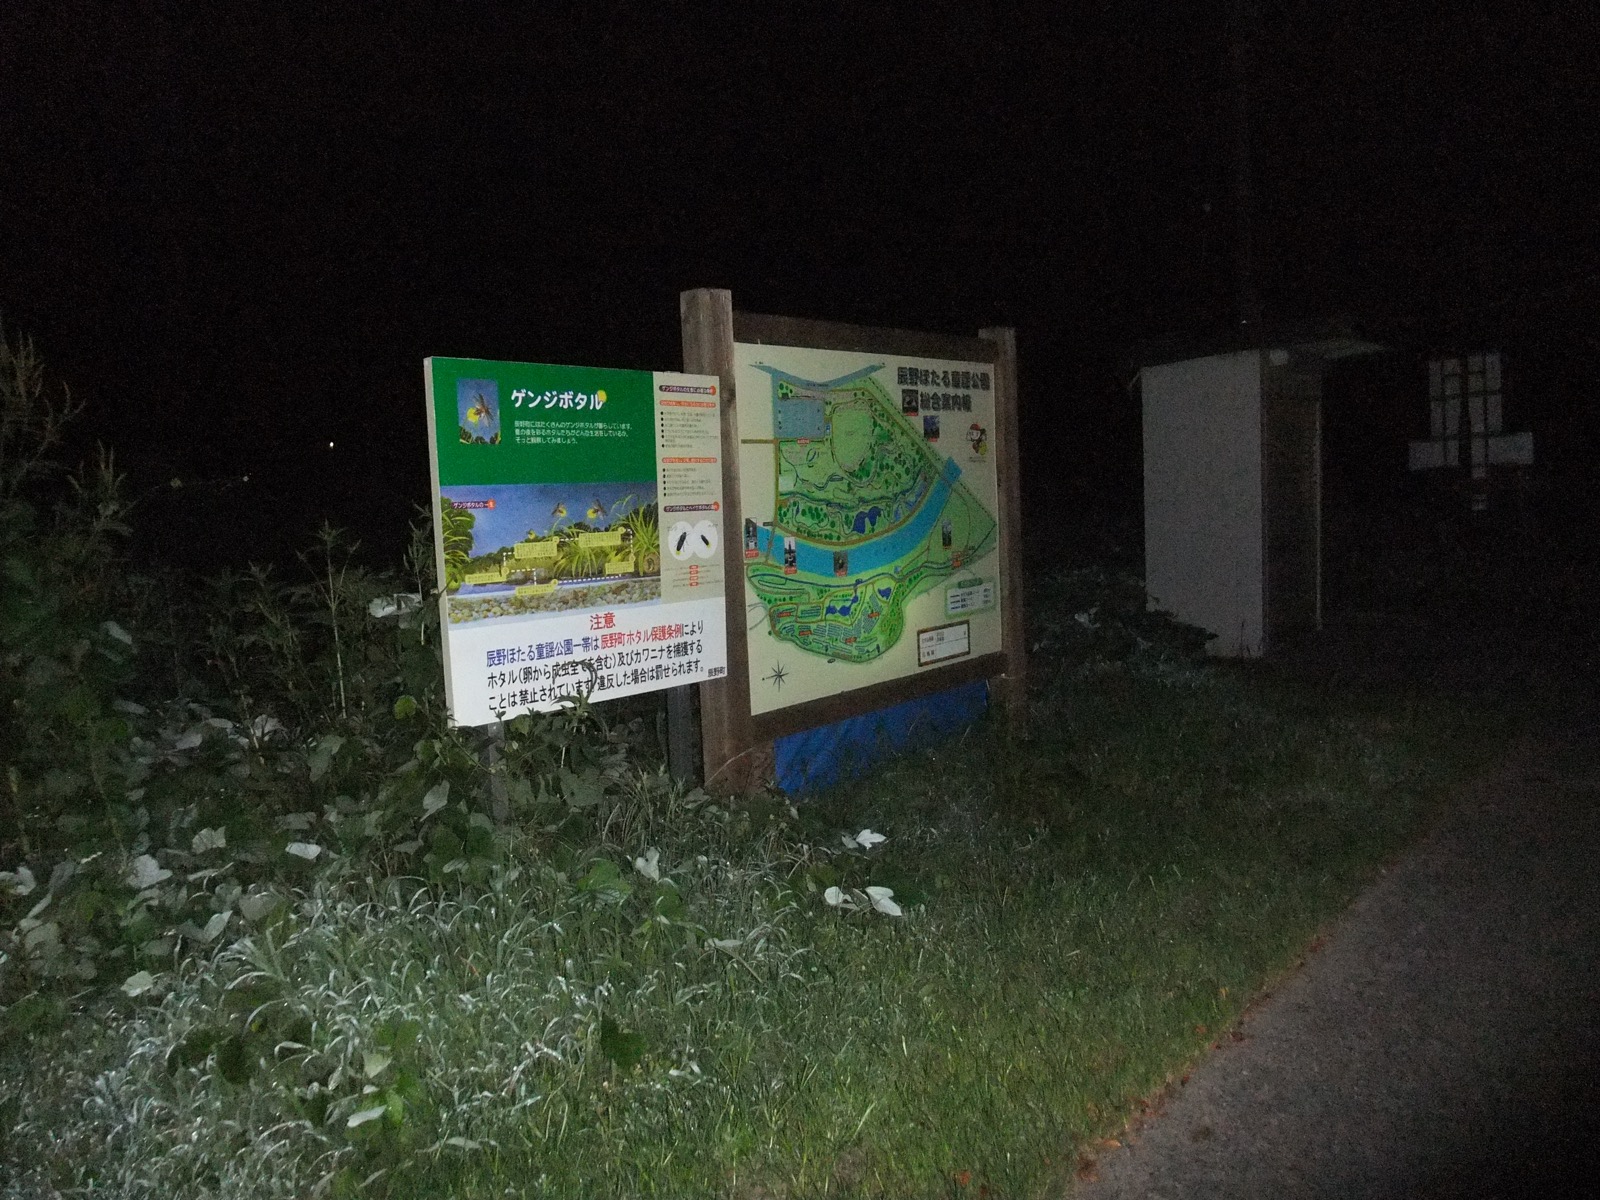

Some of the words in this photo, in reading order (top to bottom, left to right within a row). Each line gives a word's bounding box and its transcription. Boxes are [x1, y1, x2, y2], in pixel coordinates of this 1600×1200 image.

[511, 388, 603, 410] ゲンジボタル
[589, 611, 616, 630] 注意
[708, 666, 726, 679] 辰野町
